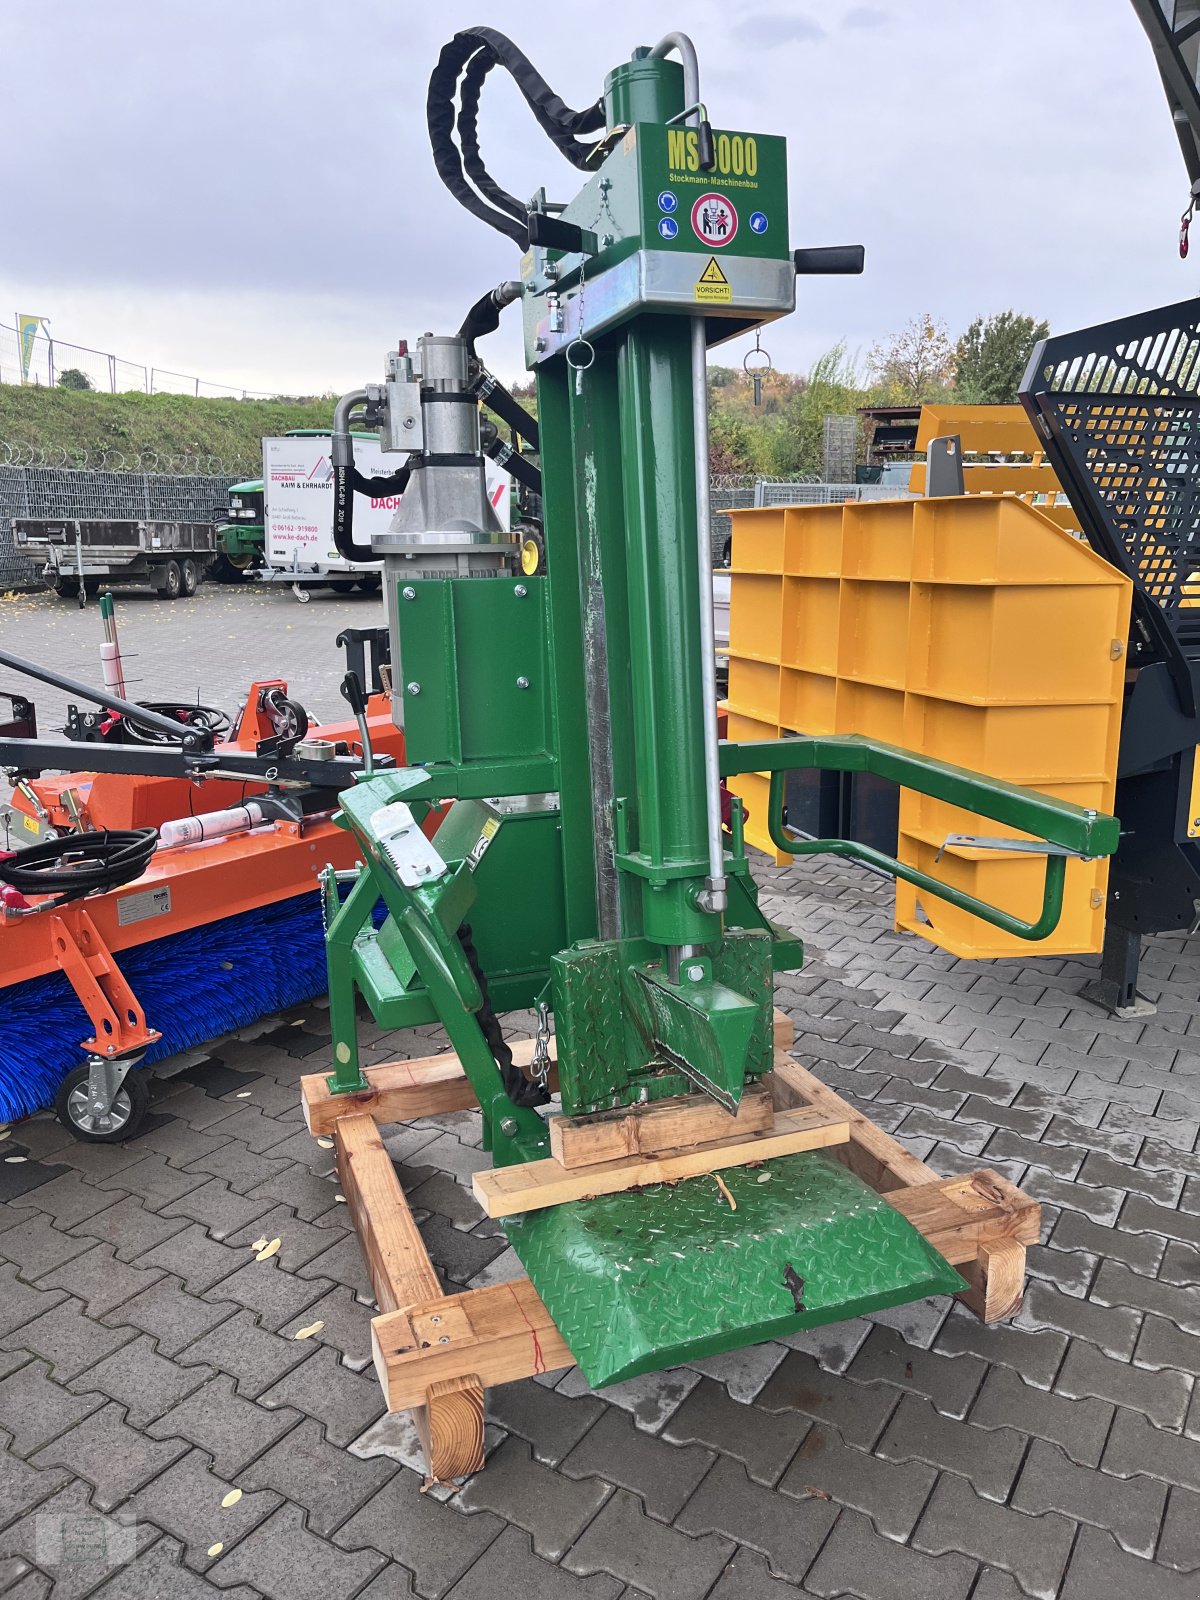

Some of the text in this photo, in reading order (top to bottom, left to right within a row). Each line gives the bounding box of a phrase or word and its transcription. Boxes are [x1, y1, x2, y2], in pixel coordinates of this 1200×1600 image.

[667, 130, 699, 171] MS
[669, 173, 758, 188] Stockmann-Maschinenbau
[696, 286, 730, 294] VORSICHT!
[272, 533, 318, 542] www.ke-dach.de
